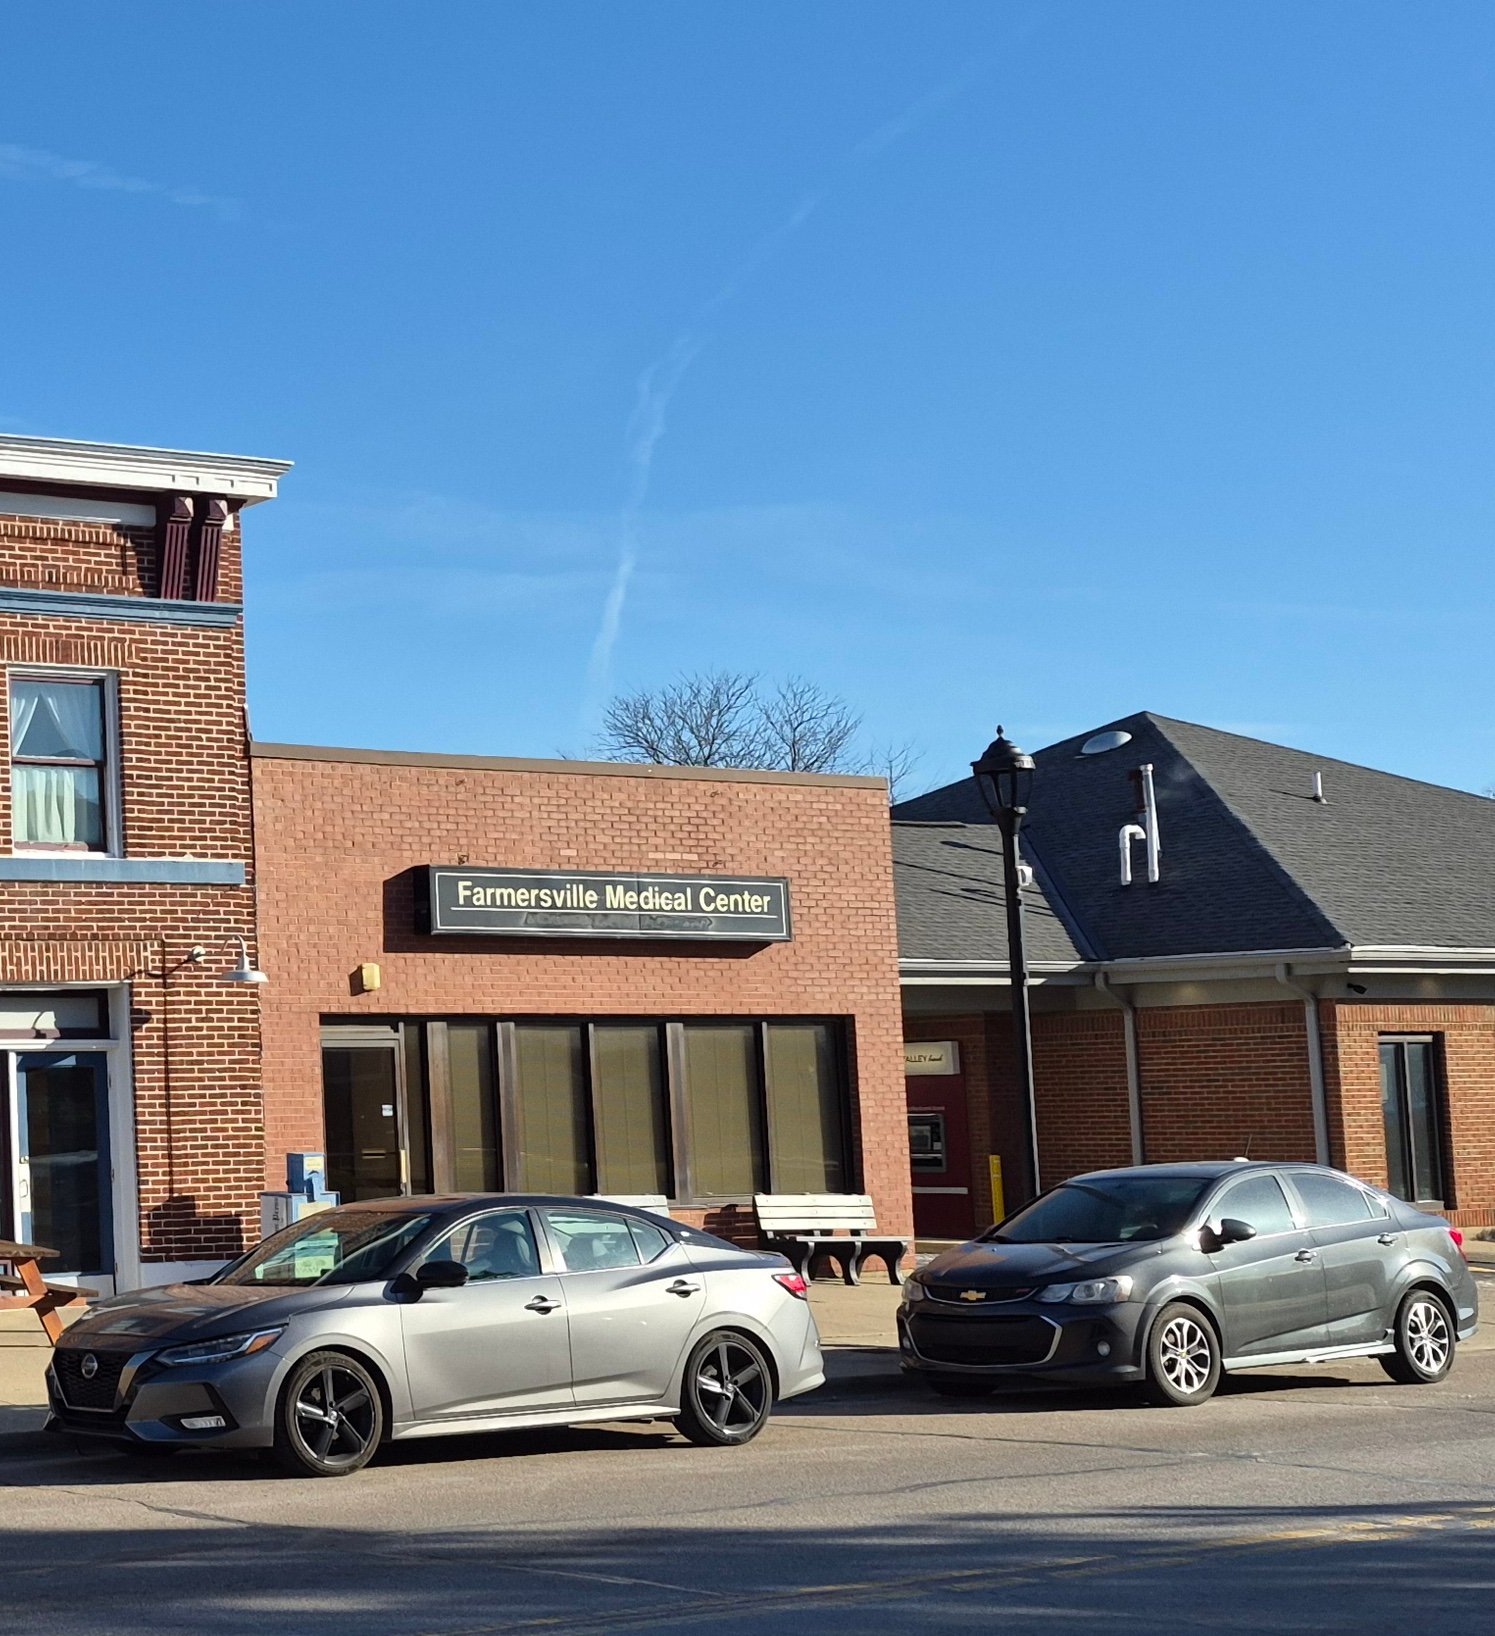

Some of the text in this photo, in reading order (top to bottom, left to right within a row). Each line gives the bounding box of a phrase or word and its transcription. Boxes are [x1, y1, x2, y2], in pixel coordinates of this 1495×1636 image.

[457, 881, 771, 913] Farmersville Medical Center
